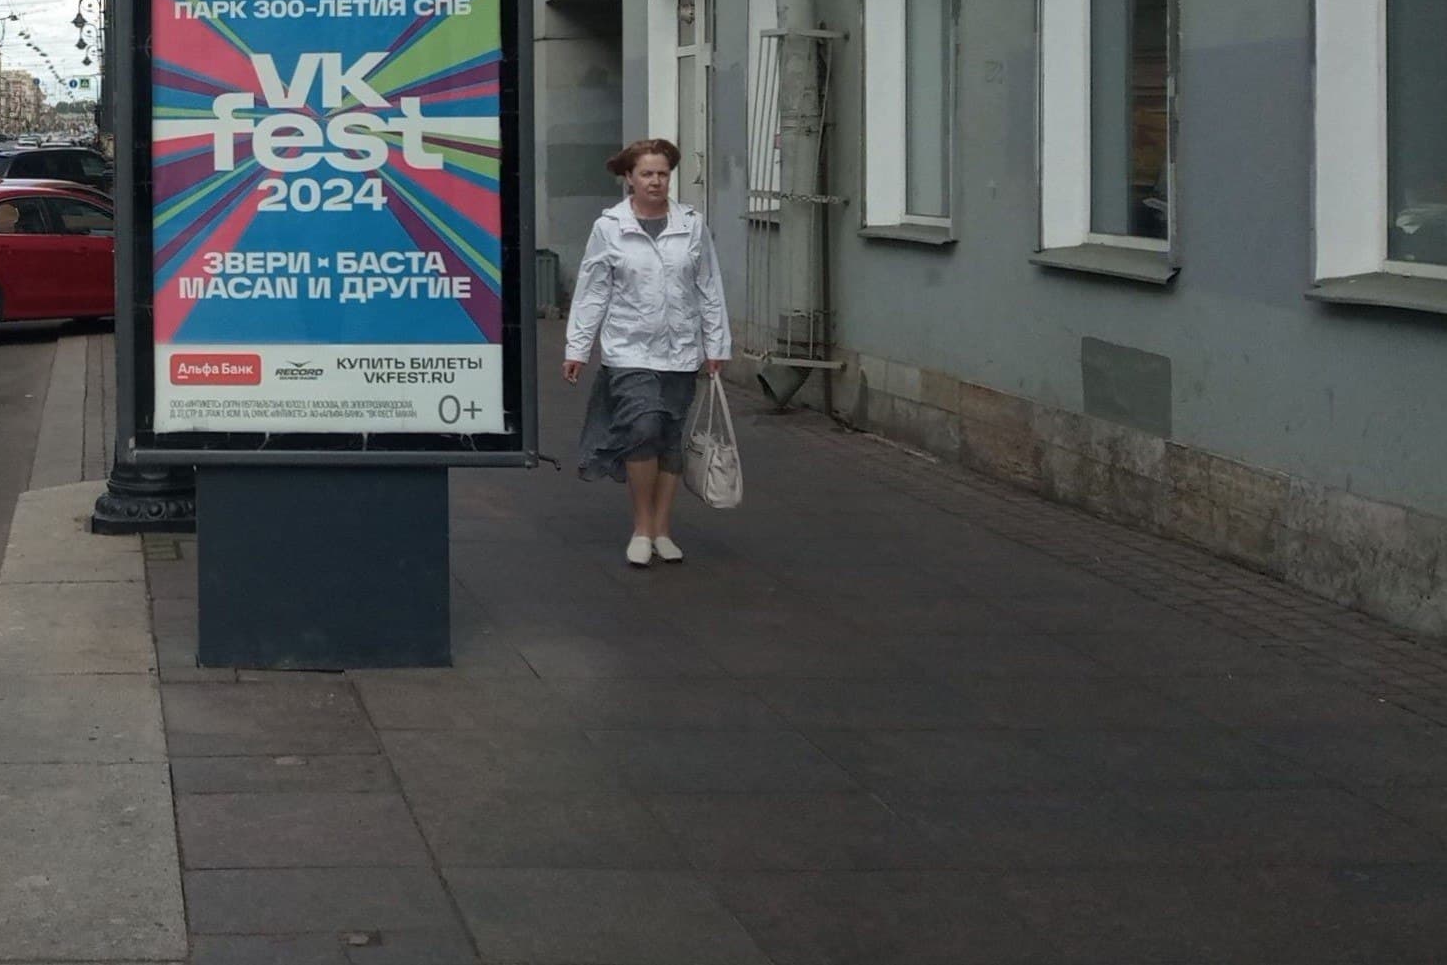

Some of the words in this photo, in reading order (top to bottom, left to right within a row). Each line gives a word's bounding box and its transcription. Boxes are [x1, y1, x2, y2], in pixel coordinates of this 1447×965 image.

[173, 0, 248, 20] ПАРК
[249, 51, 393, 109] VK
[211, 91, 444, 173] fest
[256, 177, 388, 213] 2024
[202, 251, 311, 275] ЗВЕРИ
[336, 250, 447, 274] БАСТА
[307, 277, 332, 299] И
[338, 276, 472, 304] ДРУГИЕ
[177, 363, 220, 378] Альфа
[221, 363, 254, 375] Банк
[274, 368, 324, 377] RECORD
[336, 357, 406, 371] КУПИТЬ
[409, 356, 483, 370] БИЛЕТЫ
[363, 371, 456, 384] VKFEST.RU
[438, 394, 483, 424] 0+
